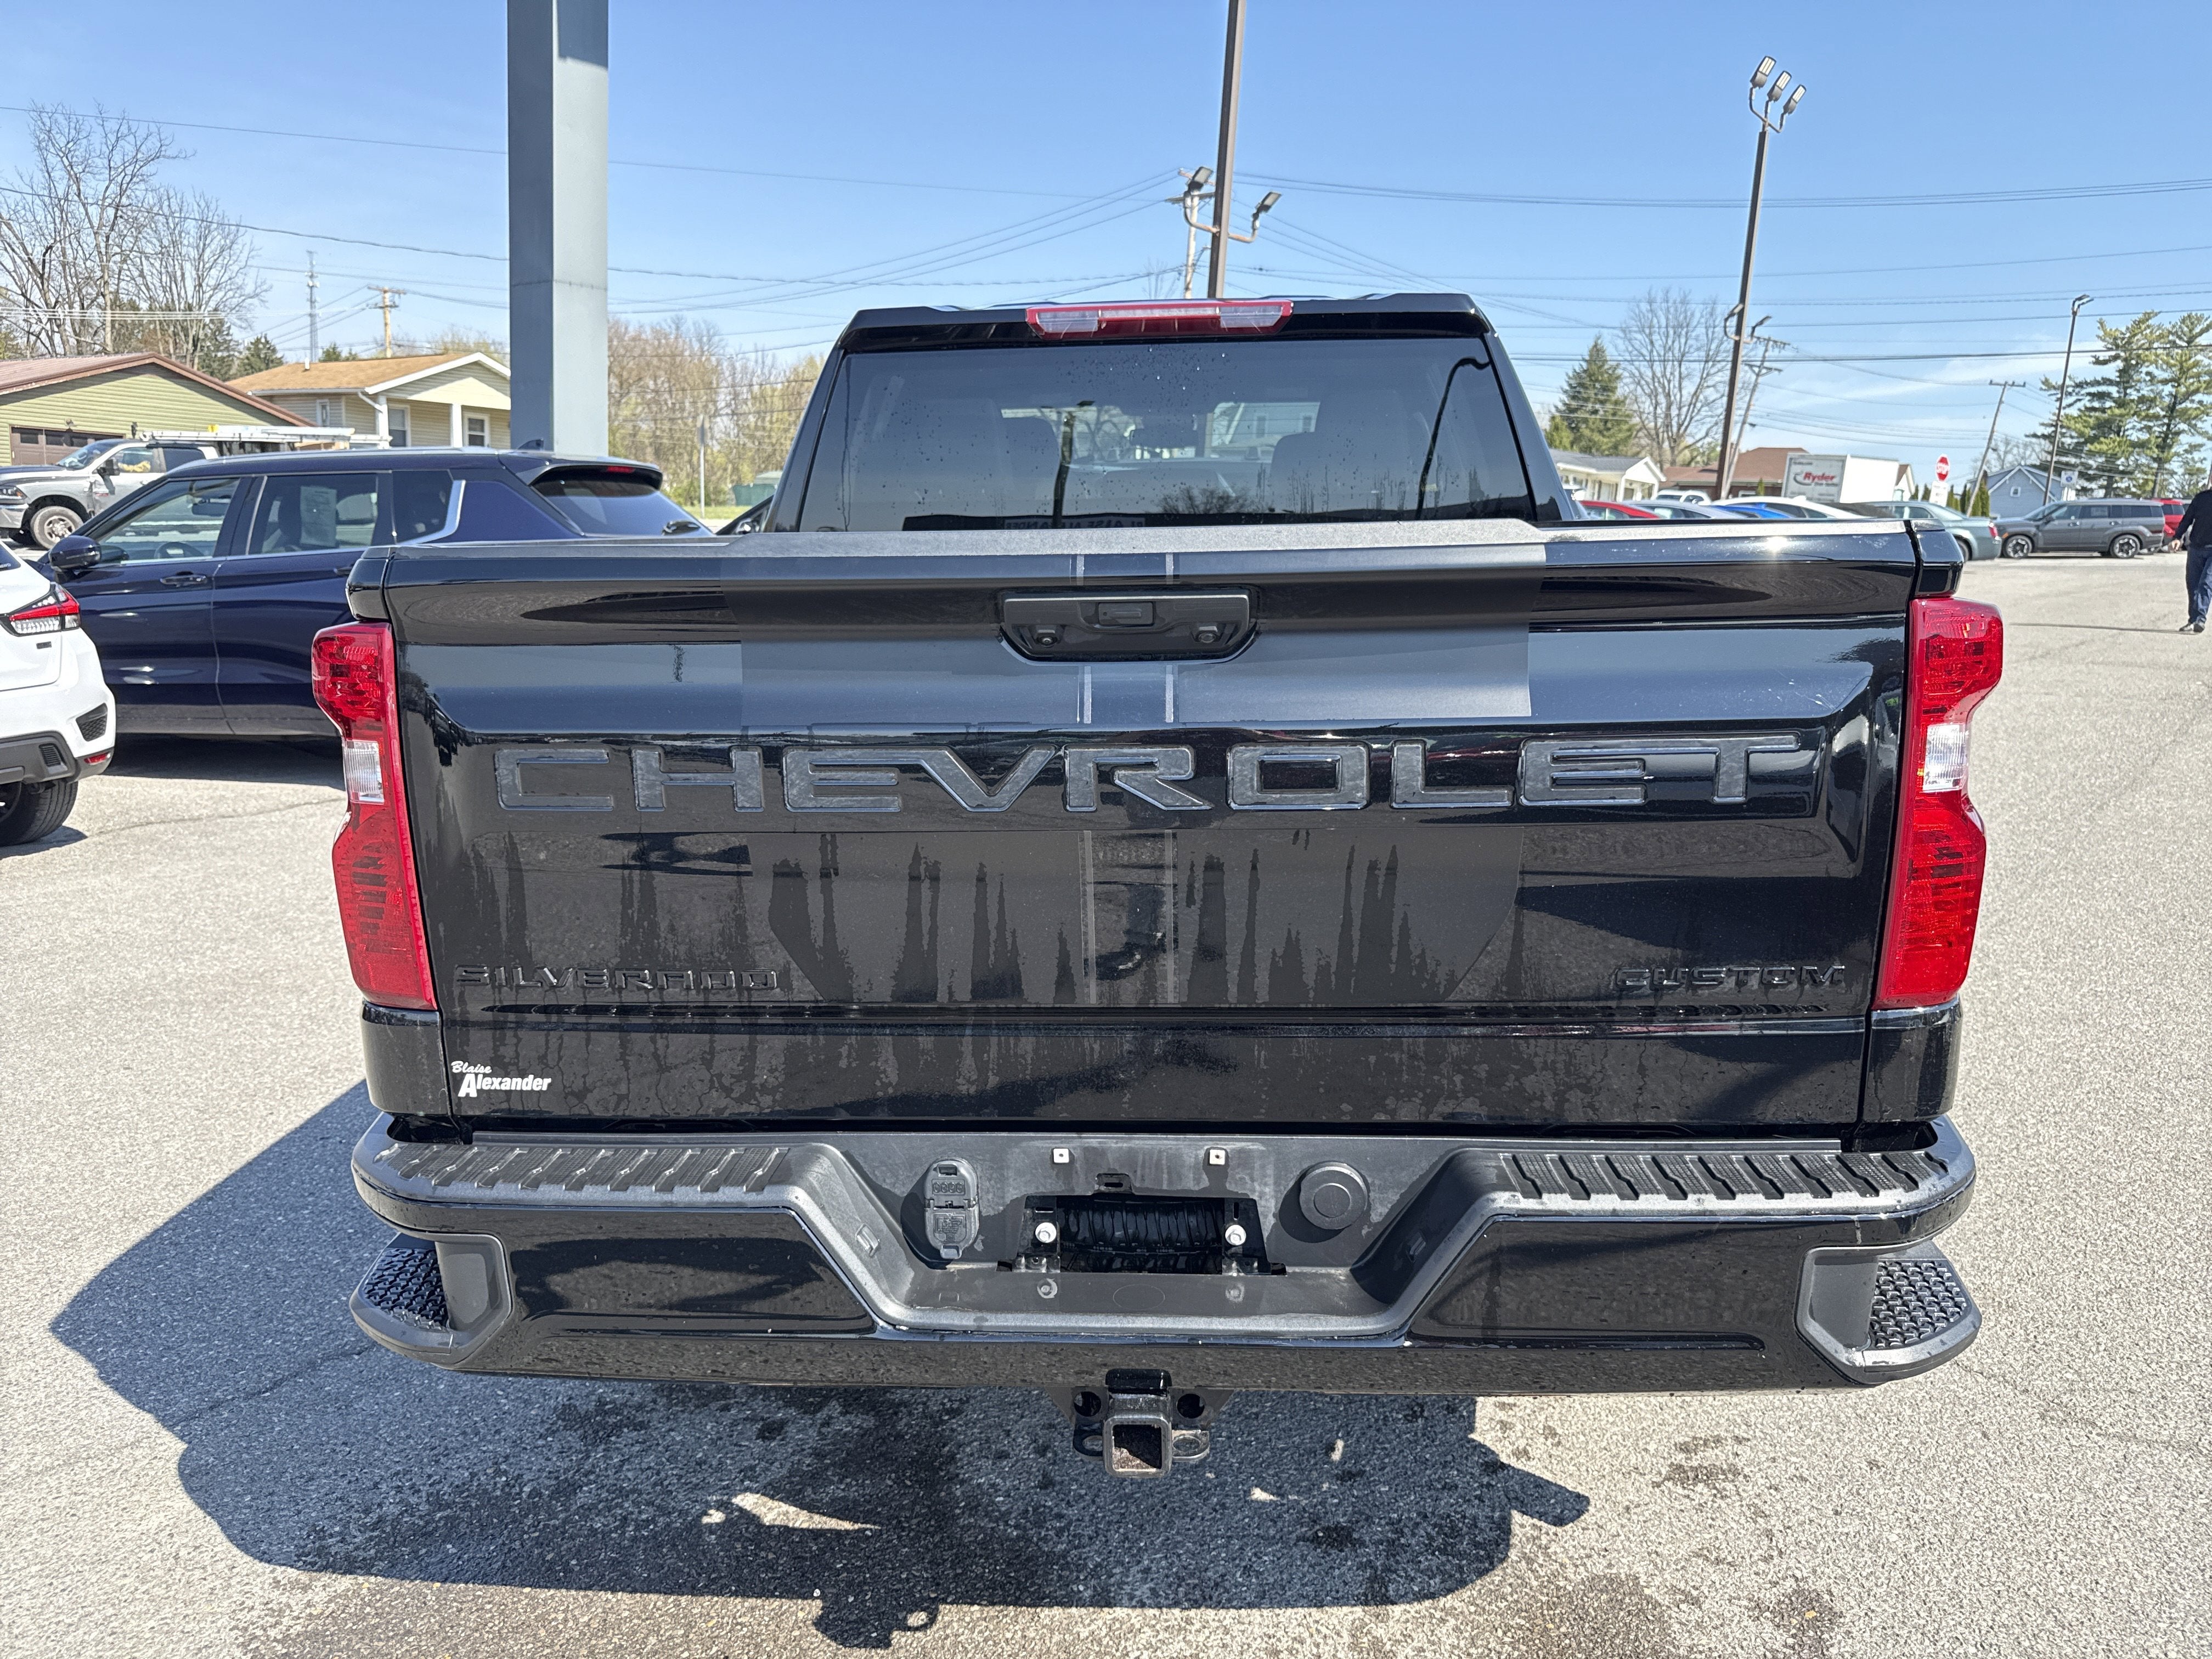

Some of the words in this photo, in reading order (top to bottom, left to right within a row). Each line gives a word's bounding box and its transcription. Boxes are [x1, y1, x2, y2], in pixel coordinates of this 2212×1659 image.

[1803, 471, 1836, 483] Ryder
[494, 732, 1802, 813] CHEVROLET
[455, 964, 777, 990] SILVERADO
[1616, 964, 1846, 987] CUSTOM
[450, 1060, 492, 1074] Blaise
[458, 1073, 552, 1097] Alexander
